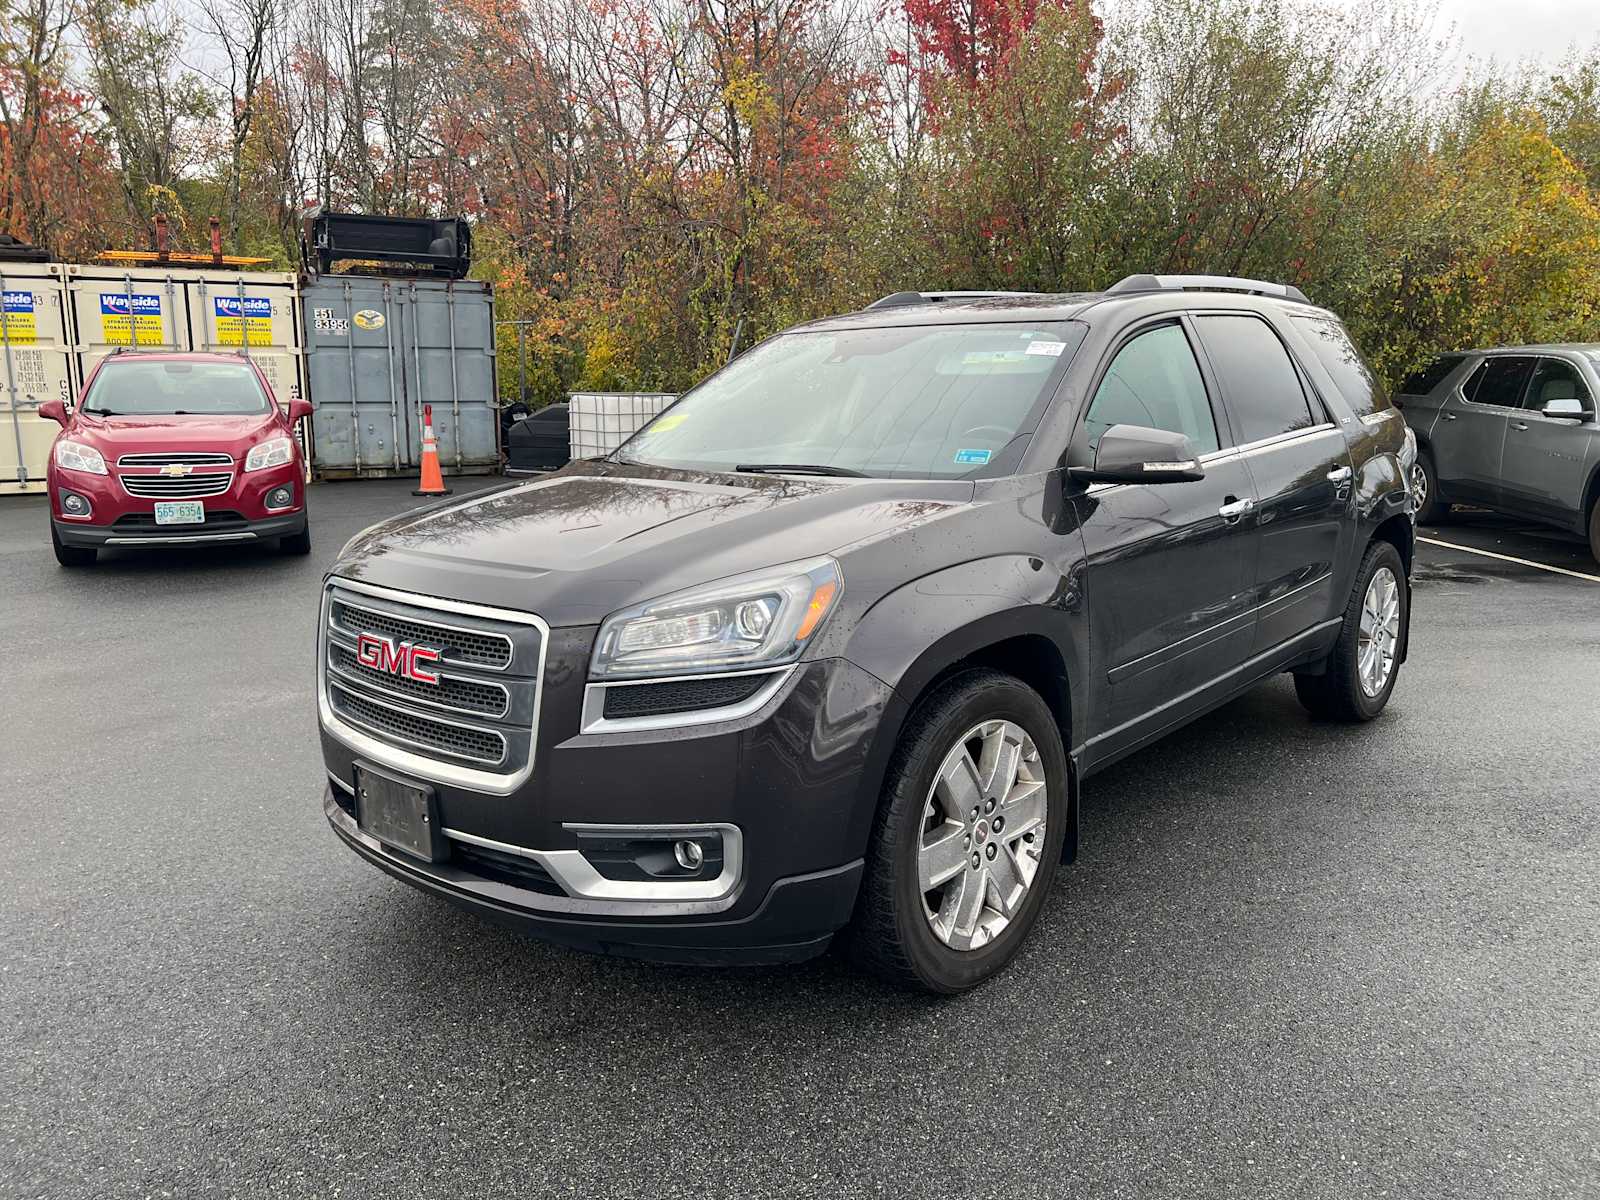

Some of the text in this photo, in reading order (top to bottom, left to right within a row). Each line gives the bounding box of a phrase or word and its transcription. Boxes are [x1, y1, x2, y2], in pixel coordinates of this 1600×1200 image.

[102, 295, 159, 308] Wayside
[216, 298, 269, 310] Wayside
[357, 631, 441, 686] GMC
